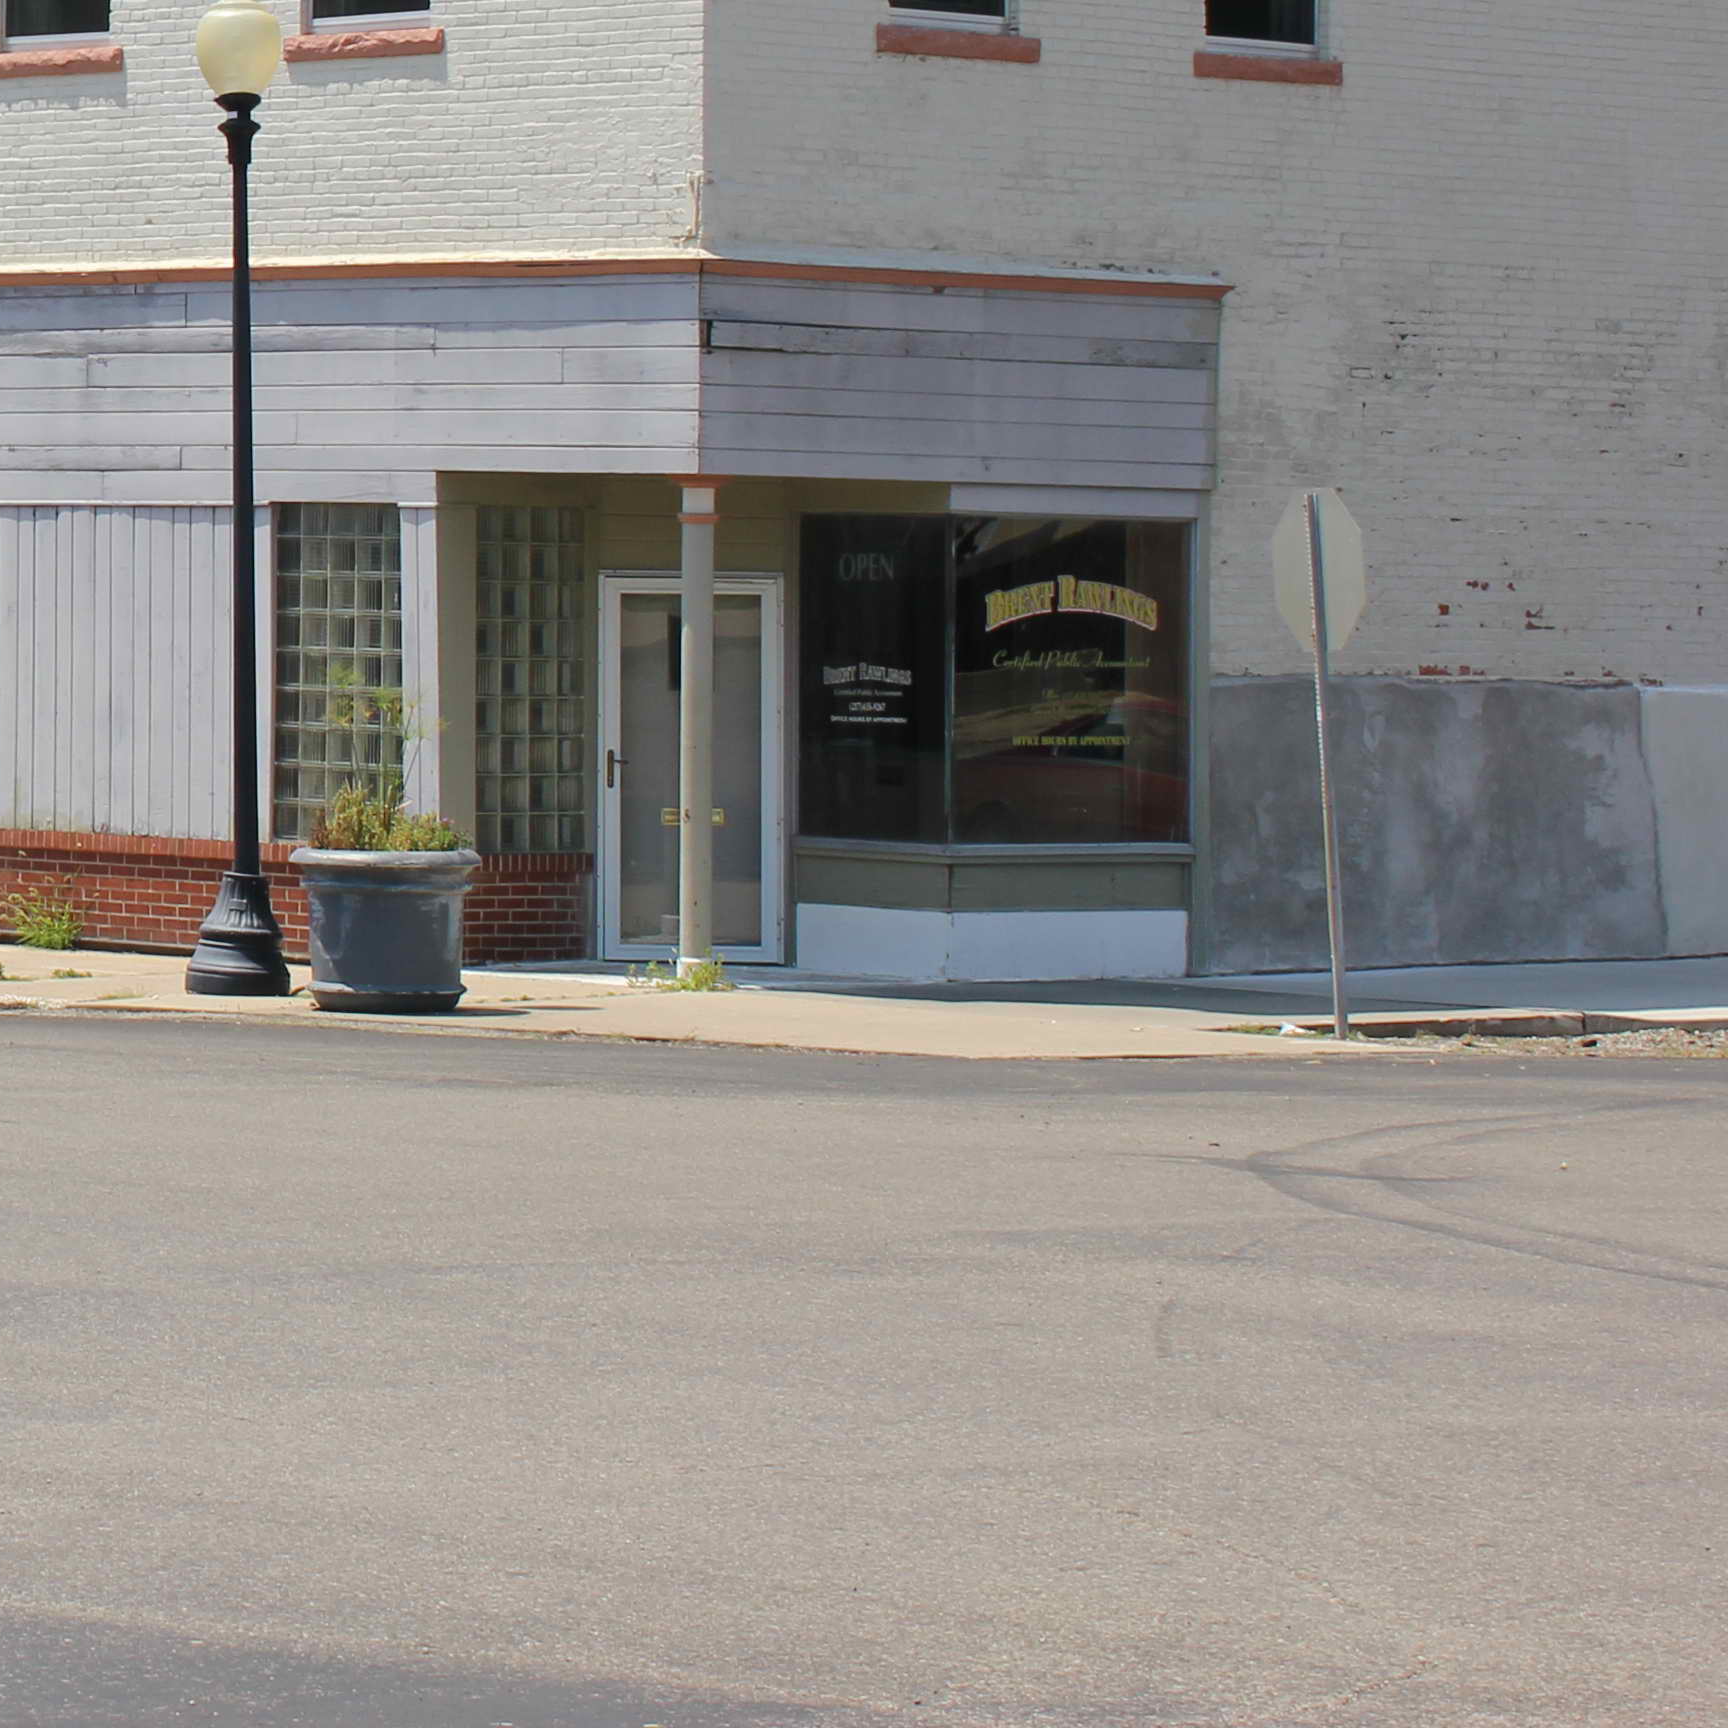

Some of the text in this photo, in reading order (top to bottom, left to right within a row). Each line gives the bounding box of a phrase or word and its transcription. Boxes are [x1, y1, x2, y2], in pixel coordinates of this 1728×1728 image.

[839, 552, 896, 581] OPEN
[984, 574, 1158, 632] BRENT RAWLINGS
